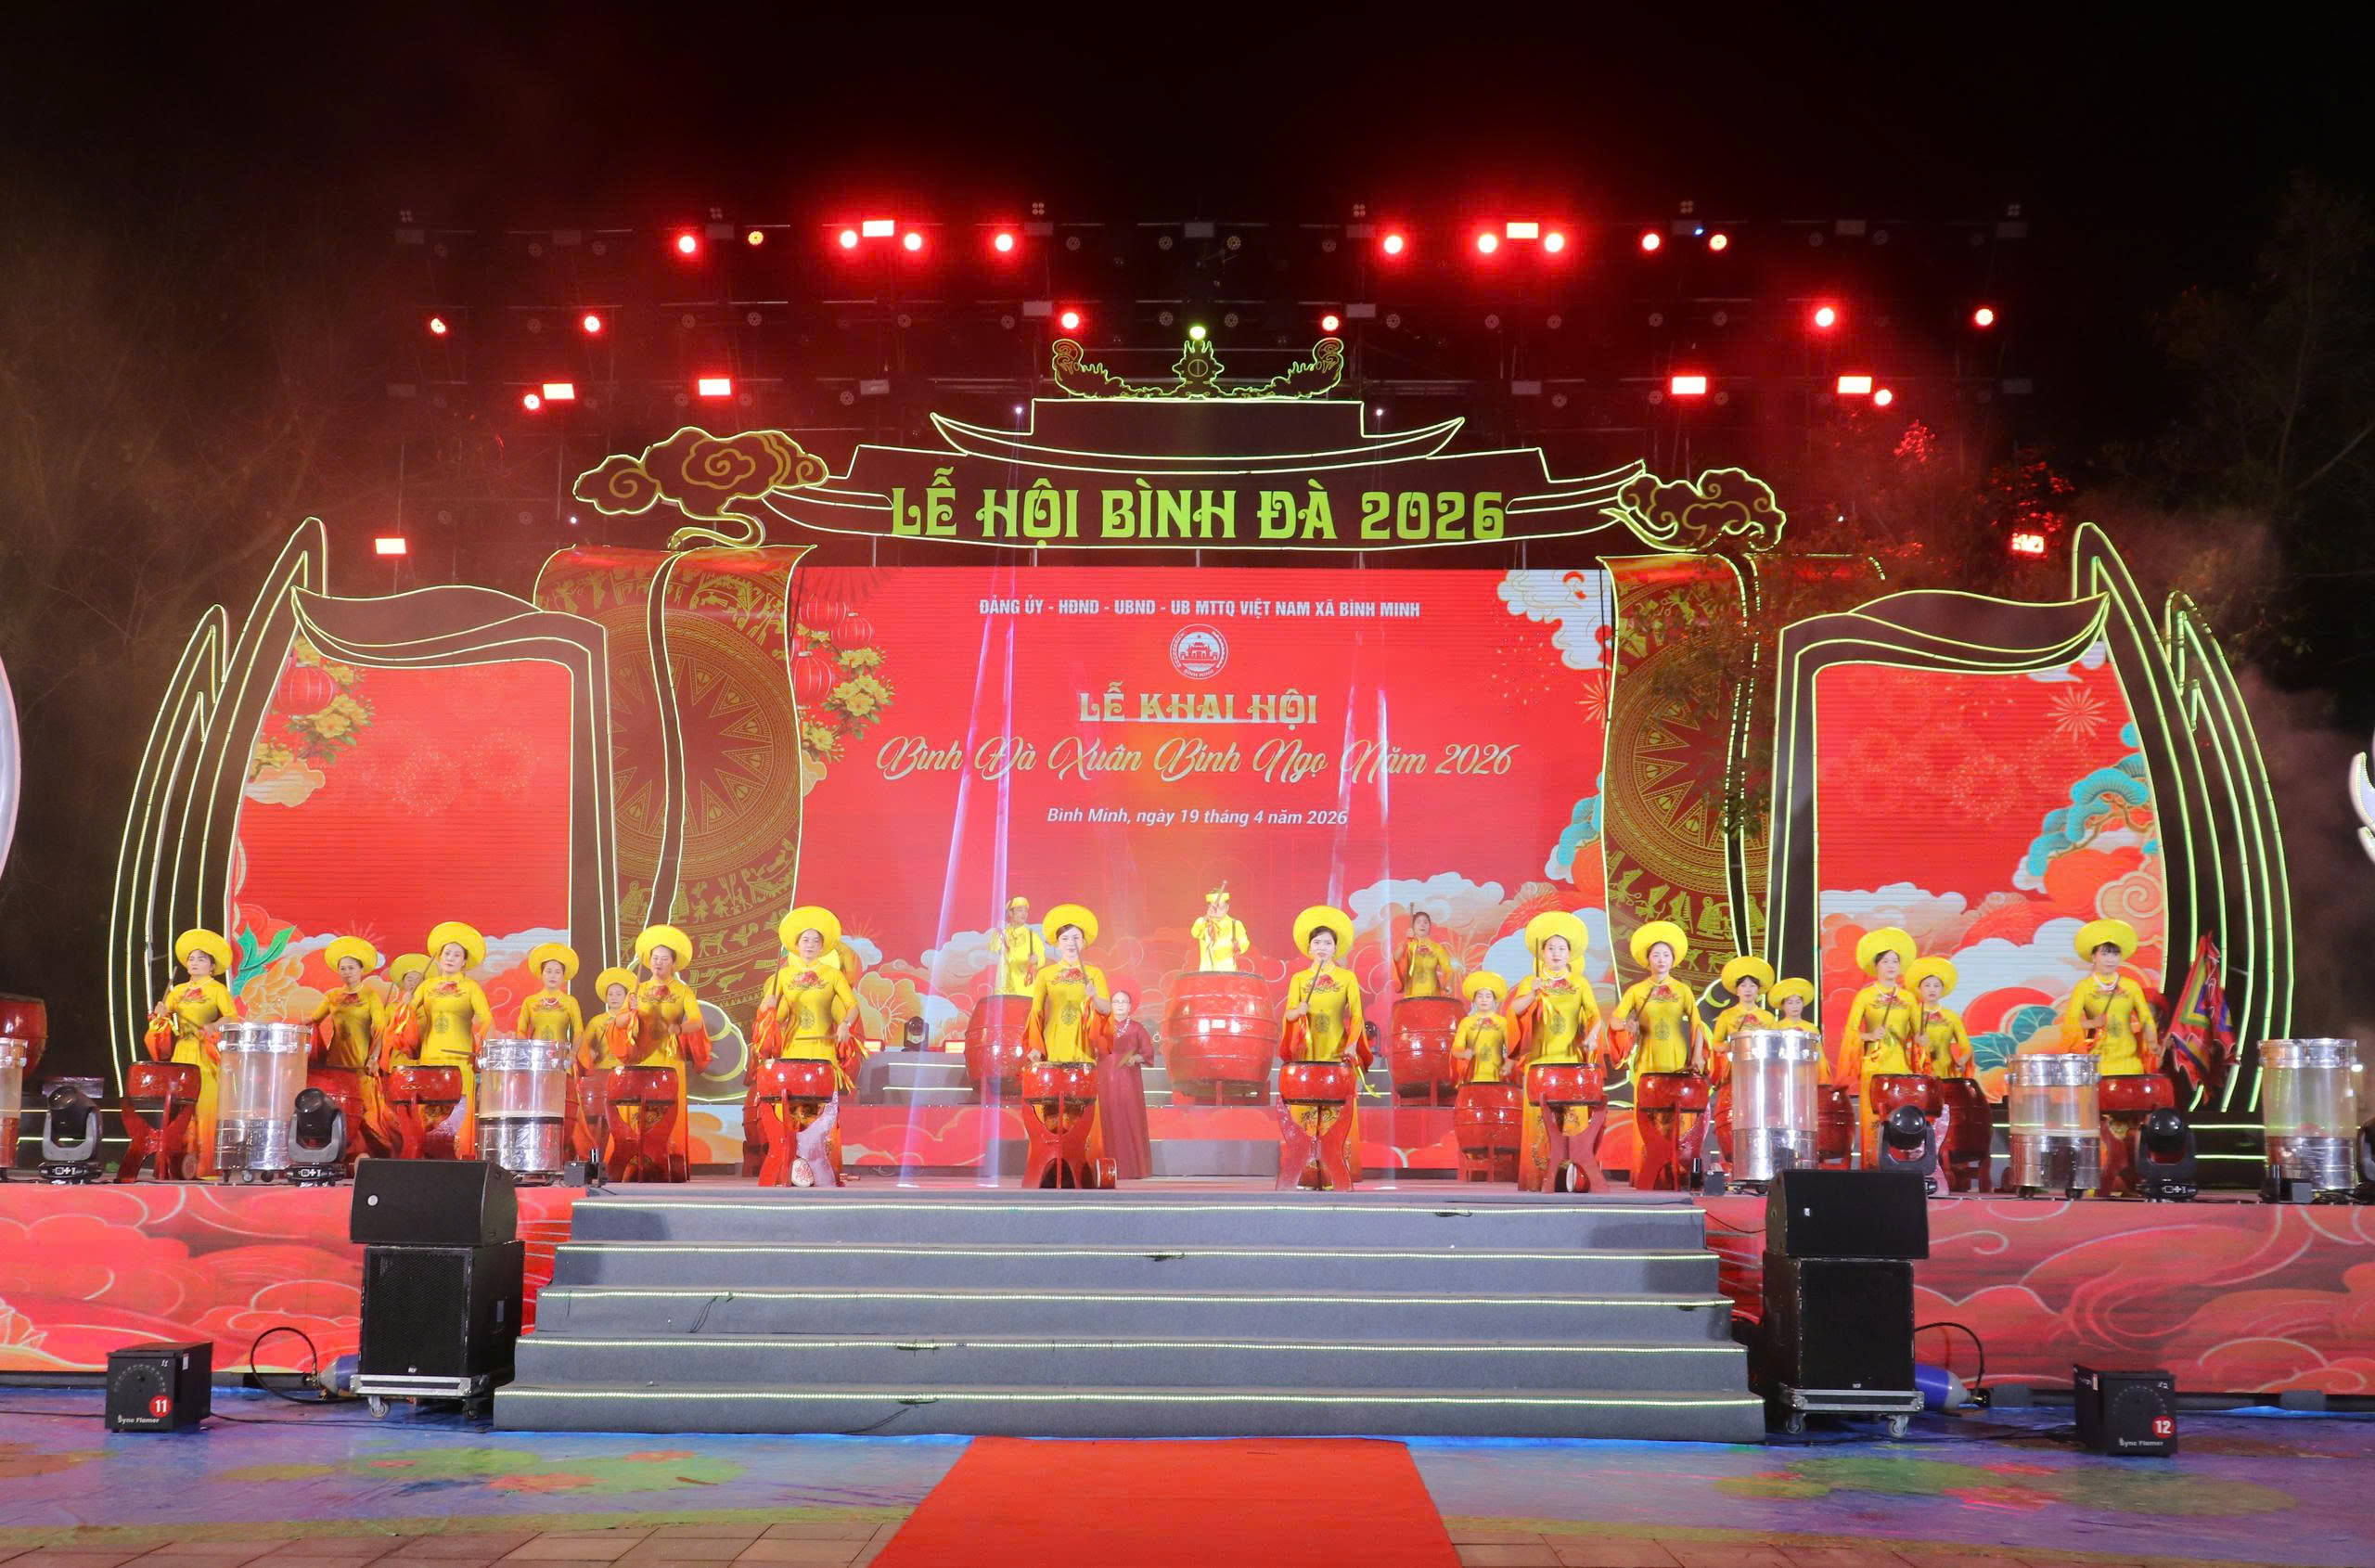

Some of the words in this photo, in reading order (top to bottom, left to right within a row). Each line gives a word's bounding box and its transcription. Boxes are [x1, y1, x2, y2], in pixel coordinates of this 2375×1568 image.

[891, 466, 957, 535] LỄ
[975, 478, 1079, 549] HỘI
[1099, 477, 1237, 538] BÌNH
[1256, 479, 1338, 539] ĐÀ
[1360, 491, 1505, 540] 2026
[979, 595, 1021, 615] ĐẢNG
[1024, 595, 1044, 614] ỦY
[1058, 600, 1099, 615] HĐND
[1114, 600, 1156, 615] UBND
[1171, 600, 1190, 615] UB
[1195, 600, 1235, 617] MTTQ
[1239, 598, 1271, 619] VIỆT
[1276, 601, 1310, 617] NAM
[1315, 598, 1335, 617] XÃ
[1339, 598, 1376, 617] BÌNH
[1380, 602, 1420, 618] MINH
[1079, 680, 1125, 723] LỄ
[1139, 693, 1235, 723] KHAI
[1247, 688, 1317, 731] HỘI
[876, 736, 964, 781] Bình
[974, 736, 1037, 781] Đà
[1047, 736, 1143, 781] Xuân
[1252, 739, 1329, 784] Ngọ
[1340, 739, 1428, 785] Năm
[1434, 743, 1521, 776] 2026
[1046, 807, 1084, 822] Bình
[1087, 807, 1132, 824] Minh,
[1136, 809, 1175, 827] ngày
[1180, 809, 1200, 824] 19
[1203, 809, 1250, 828] tháng
[1253, 810, 1265, 824] 4
[1267, 809, 1303, 825] năm
[1306, 810, 1349, 825] 2026
[155, 1399, 168, 1413] 11
[2154, 1420, 2172, 1434] 12
